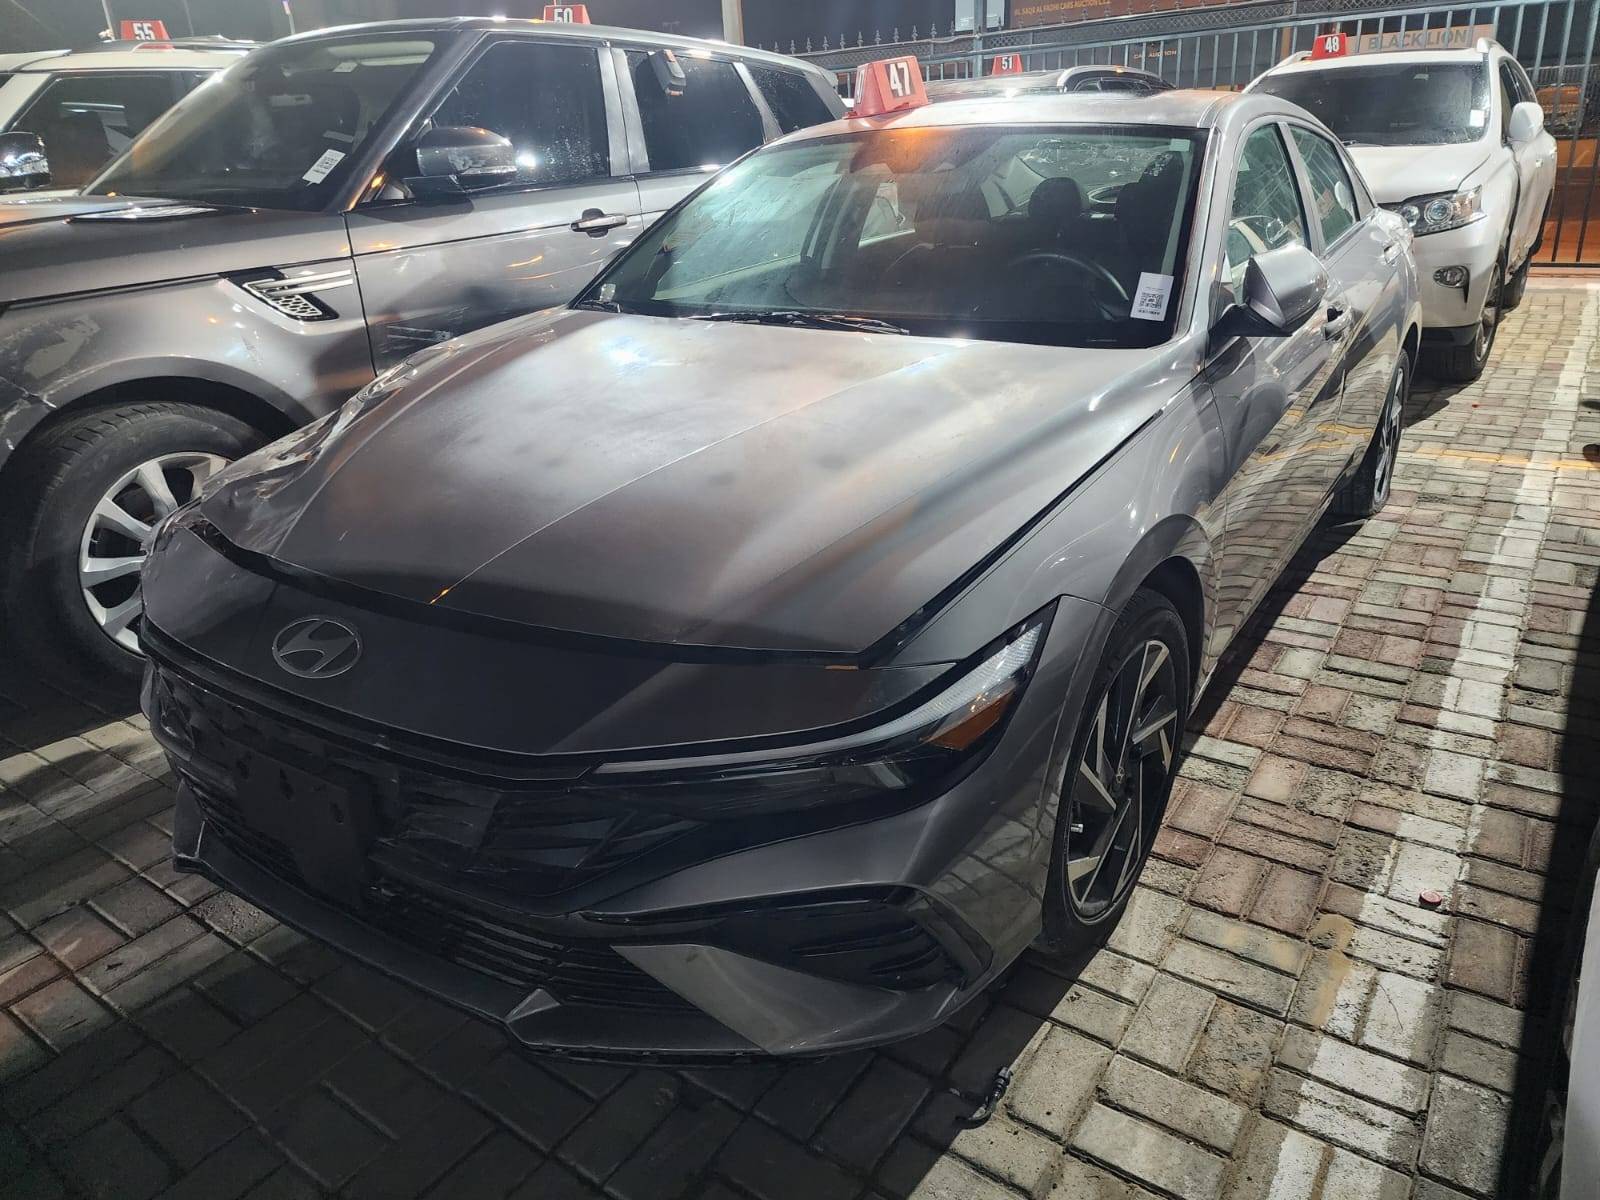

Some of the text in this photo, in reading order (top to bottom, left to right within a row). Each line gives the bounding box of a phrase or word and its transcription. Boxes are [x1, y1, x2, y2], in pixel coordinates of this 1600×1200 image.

[554, 8, 573, 24] 50
[133, 22, 156, 40] 55
[1427, 29, 1467, 45] LION
[1325, 36, 1340, 53] 48
[1002, 56, 1013, 70] 51
[890, 62, 911, 97] 47
